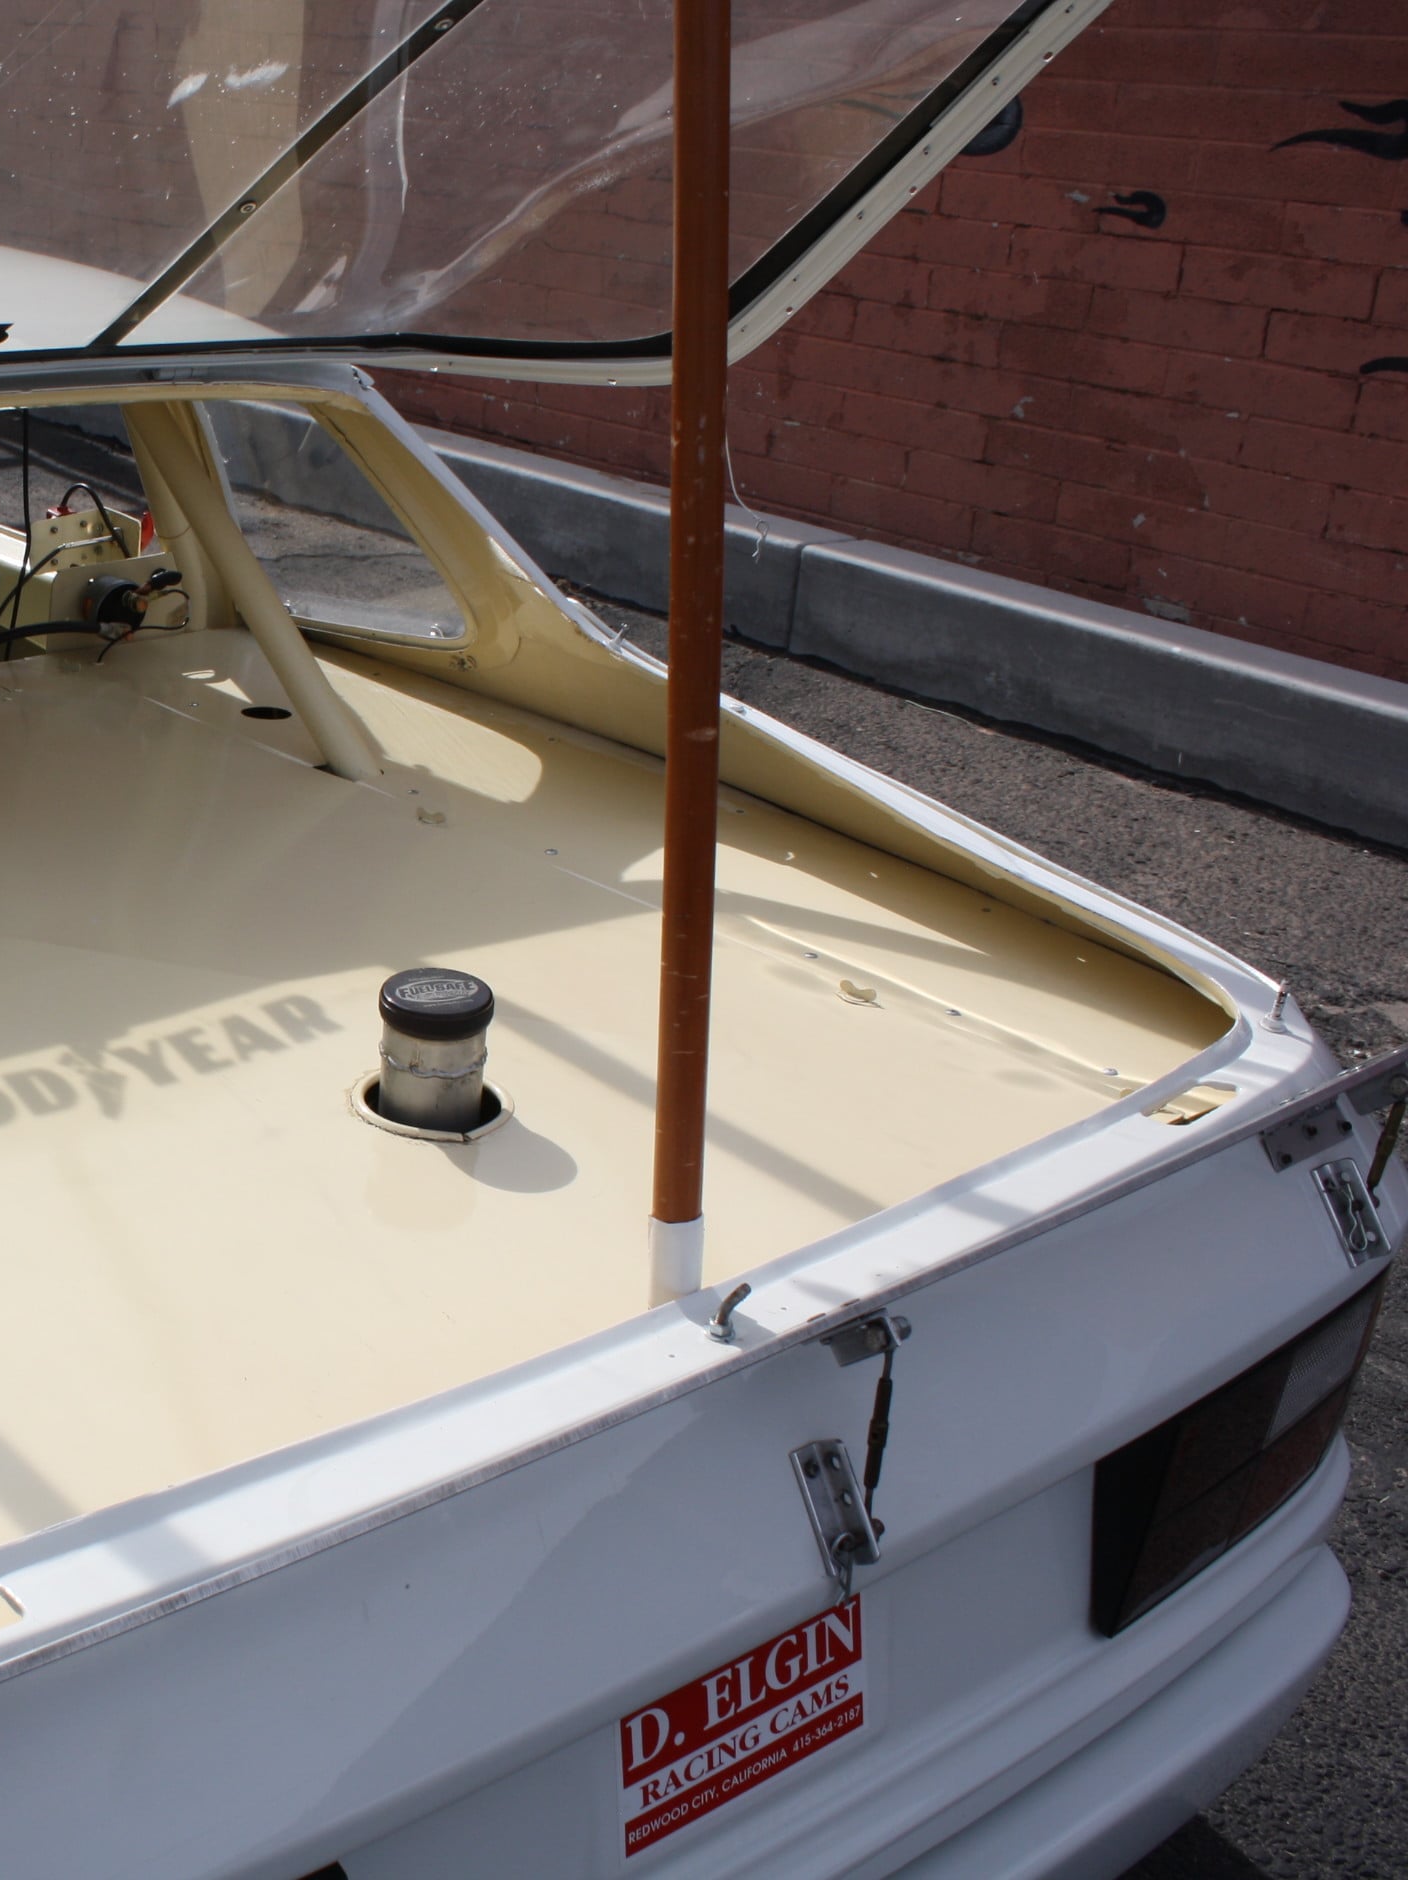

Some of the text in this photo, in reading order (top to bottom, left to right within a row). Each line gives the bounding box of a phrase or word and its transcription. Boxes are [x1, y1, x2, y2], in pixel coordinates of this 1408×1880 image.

[626, 1601, 856, 1772] D. ELGIN
[640, 1674, 849, 1809] RACING CAMS
[628, 1705, 861, 1845] REDWOOD CITY, CALIFORNIA 415-364-2187
